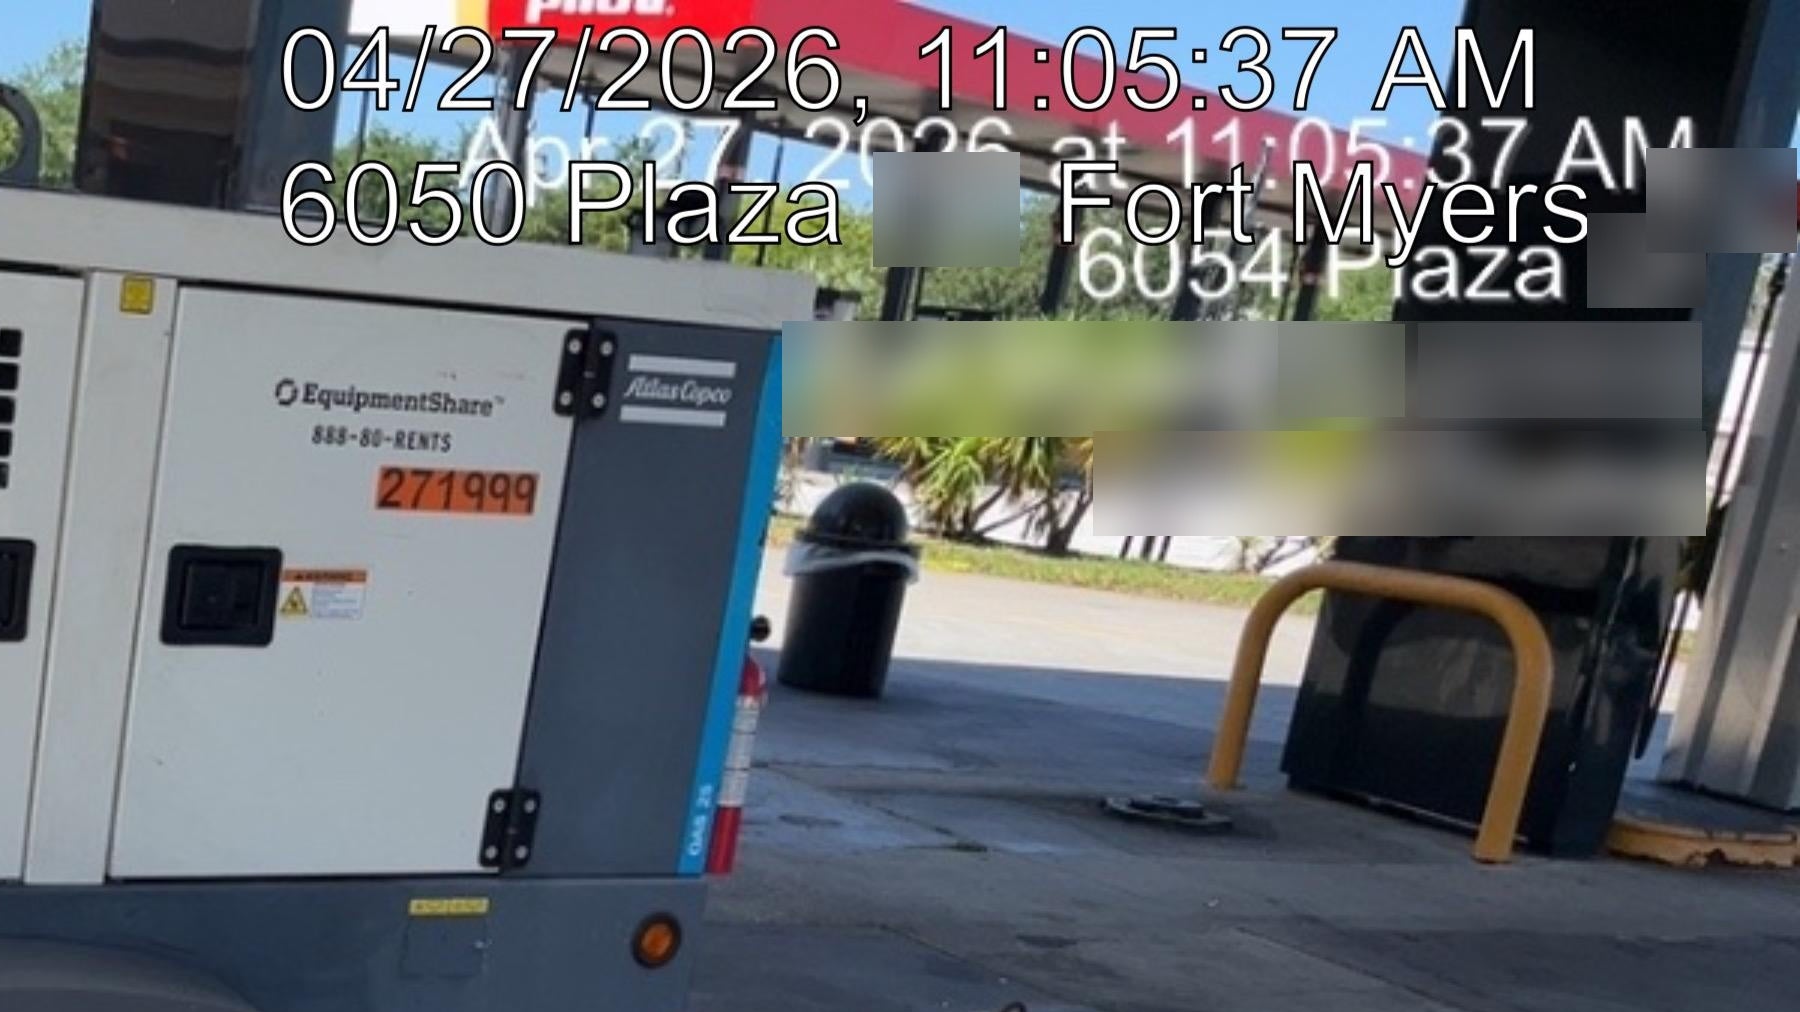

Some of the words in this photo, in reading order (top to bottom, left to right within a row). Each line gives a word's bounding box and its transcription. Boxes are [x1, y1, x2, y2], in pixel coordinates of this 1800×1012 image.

[623, 375, 679, 400] Atlas
[680, 380, 732, 407] Copco
[311, 424, 452, 453] 888-80-RENTS
[376, 467, 538, 514] 271999
